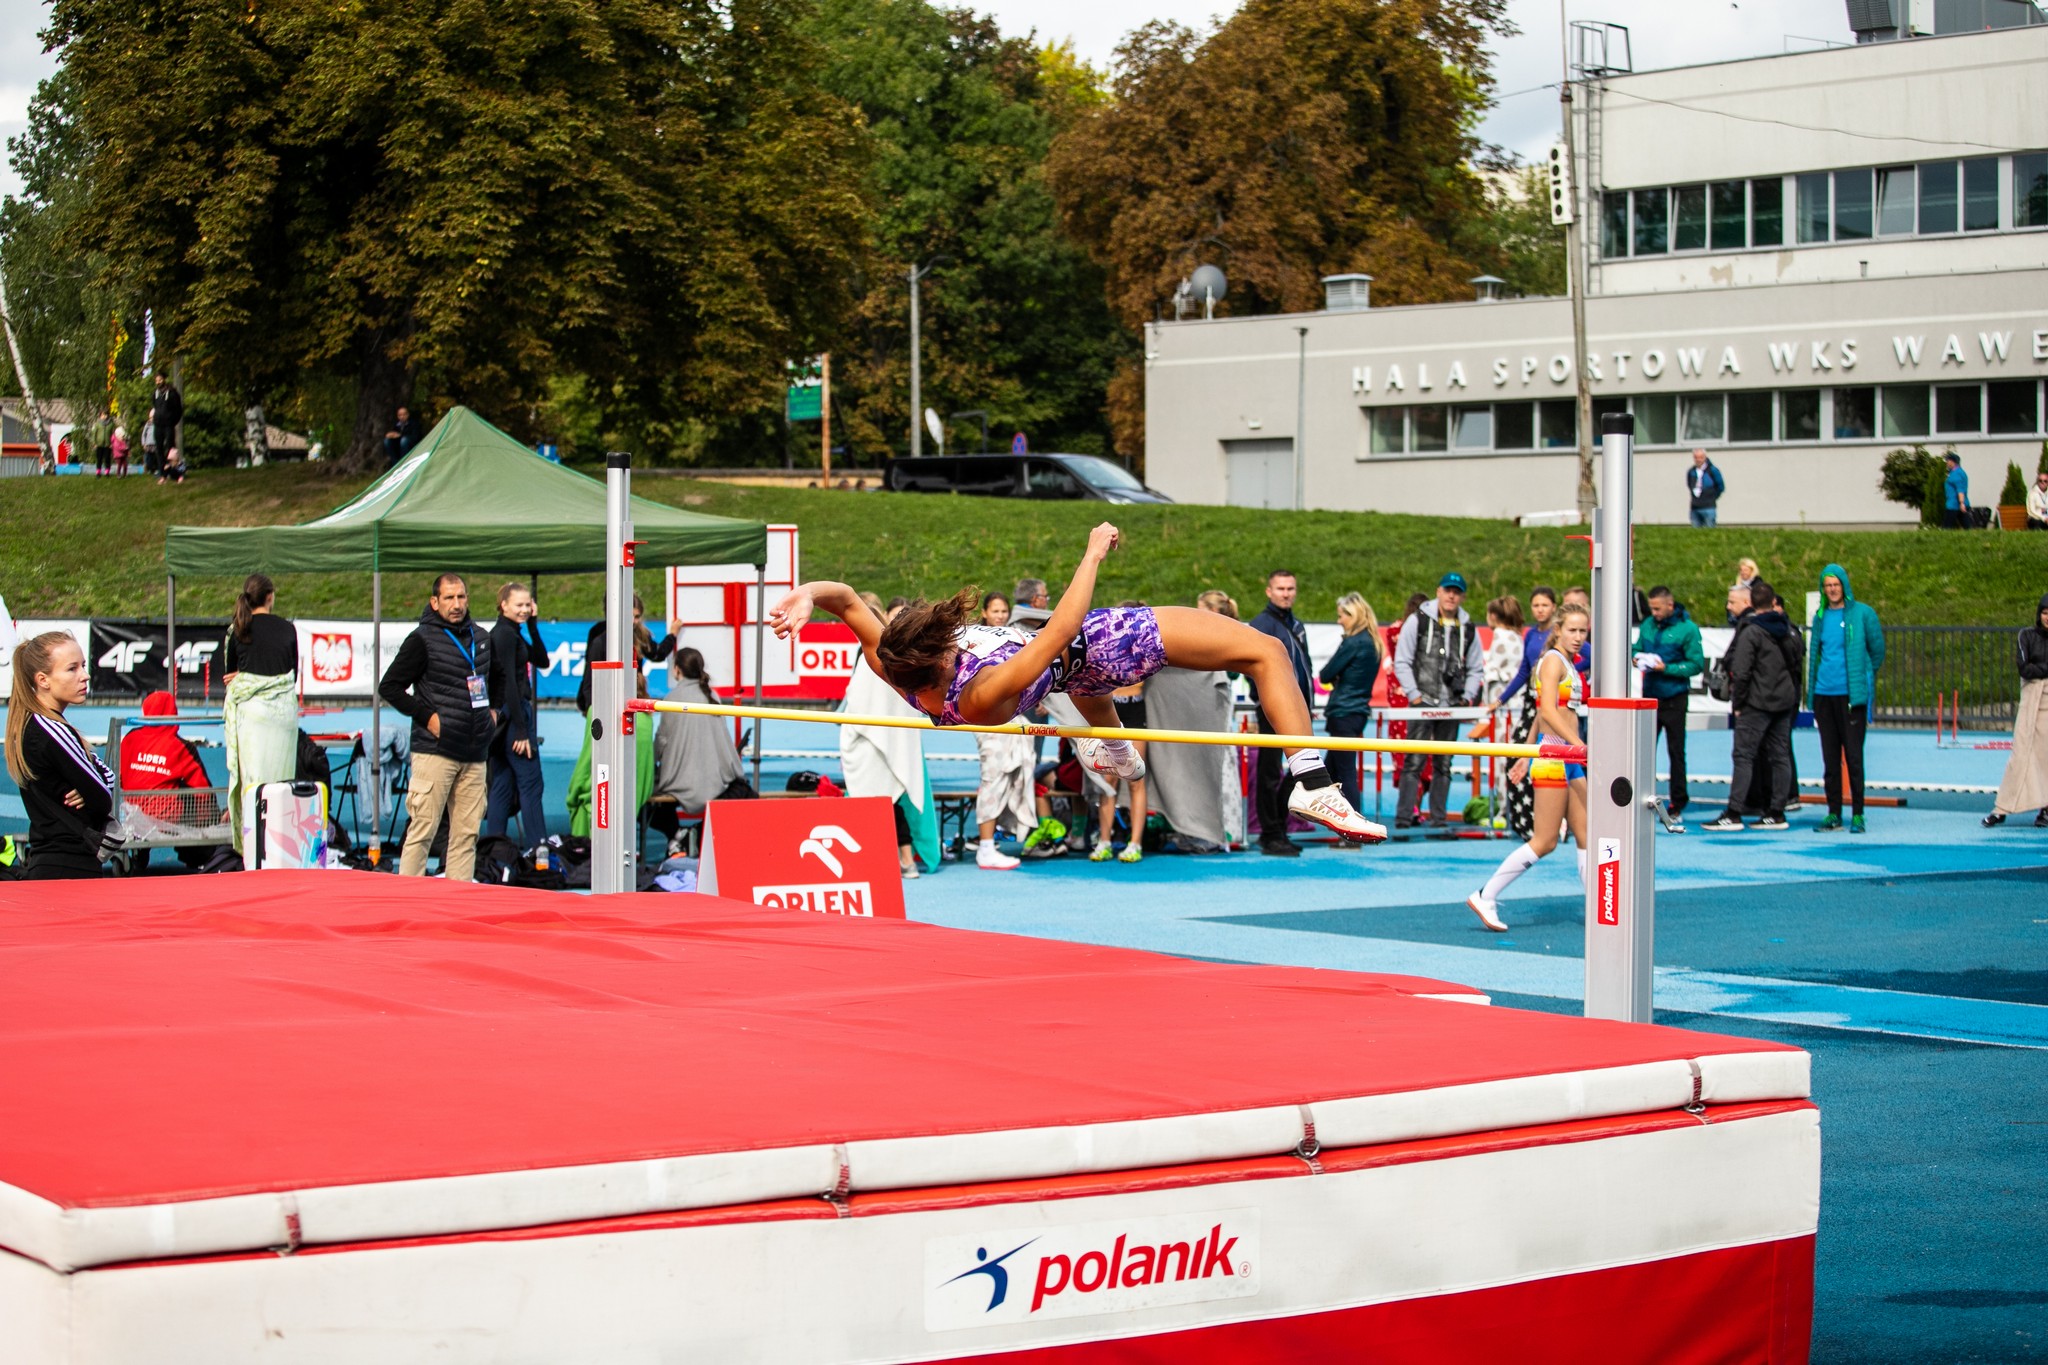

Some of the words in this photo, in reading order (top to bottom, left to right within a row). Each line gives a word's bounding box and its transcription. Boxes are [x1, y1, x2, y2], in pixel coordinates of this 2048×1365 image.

[1352, 360, 1467, 392] HALA
[1493, 346, 1741, 386] SPORTOWA
[1768, 339, 1858, 372] WKS
[98, 641, 153, 673] 4F
[163, 641, 219, 674] 4F
[802, 649, 853, 670] ORL
[761, 889, 865, 915] ORLEN
[1602, 866, 1615, 922] polanik
[1030, 1222, 1240, 1314] polanik
